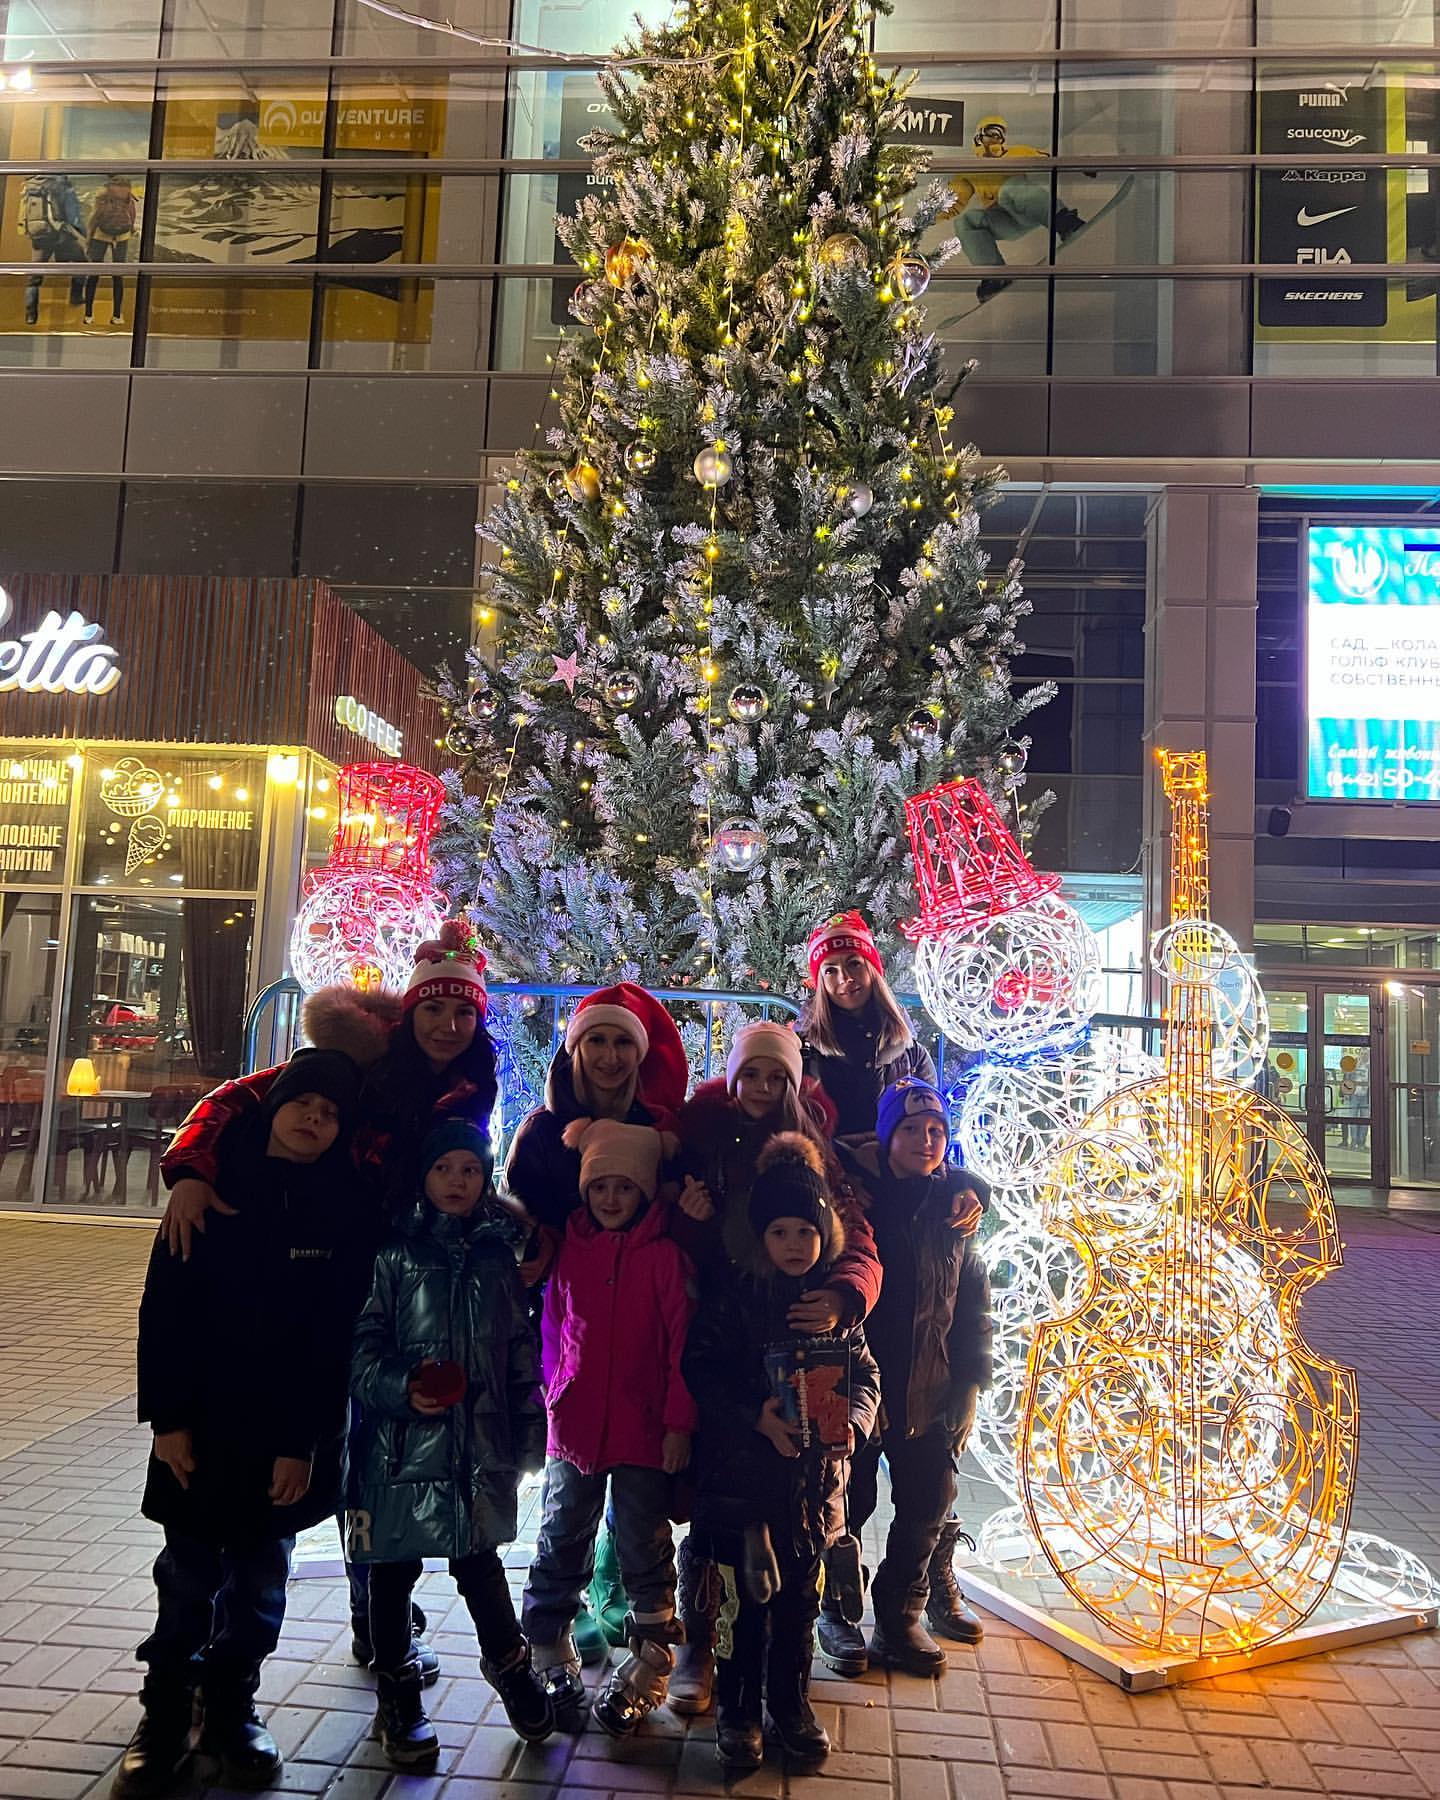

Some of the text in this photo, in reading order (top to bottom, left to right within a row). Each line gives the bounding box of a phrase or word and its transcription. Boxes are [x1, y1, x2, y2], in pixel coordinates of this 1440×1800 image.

[1299, 93, 1343, 107] PUMA
[301, 109, 425, 125] OUVENTURE
[1287, 128, 1349, 141] saucony
[1305, 169, 1366, 183] Kappa
[1296, 247, 1352, 264] FILA
[1284, 291, 1365, 301] SKECHERS
[336, 695, 403, 757] COFFEE
[167, 808, 254, 831] МОРОЖЕНОЕ
[419, 983, 443, 998] OH
